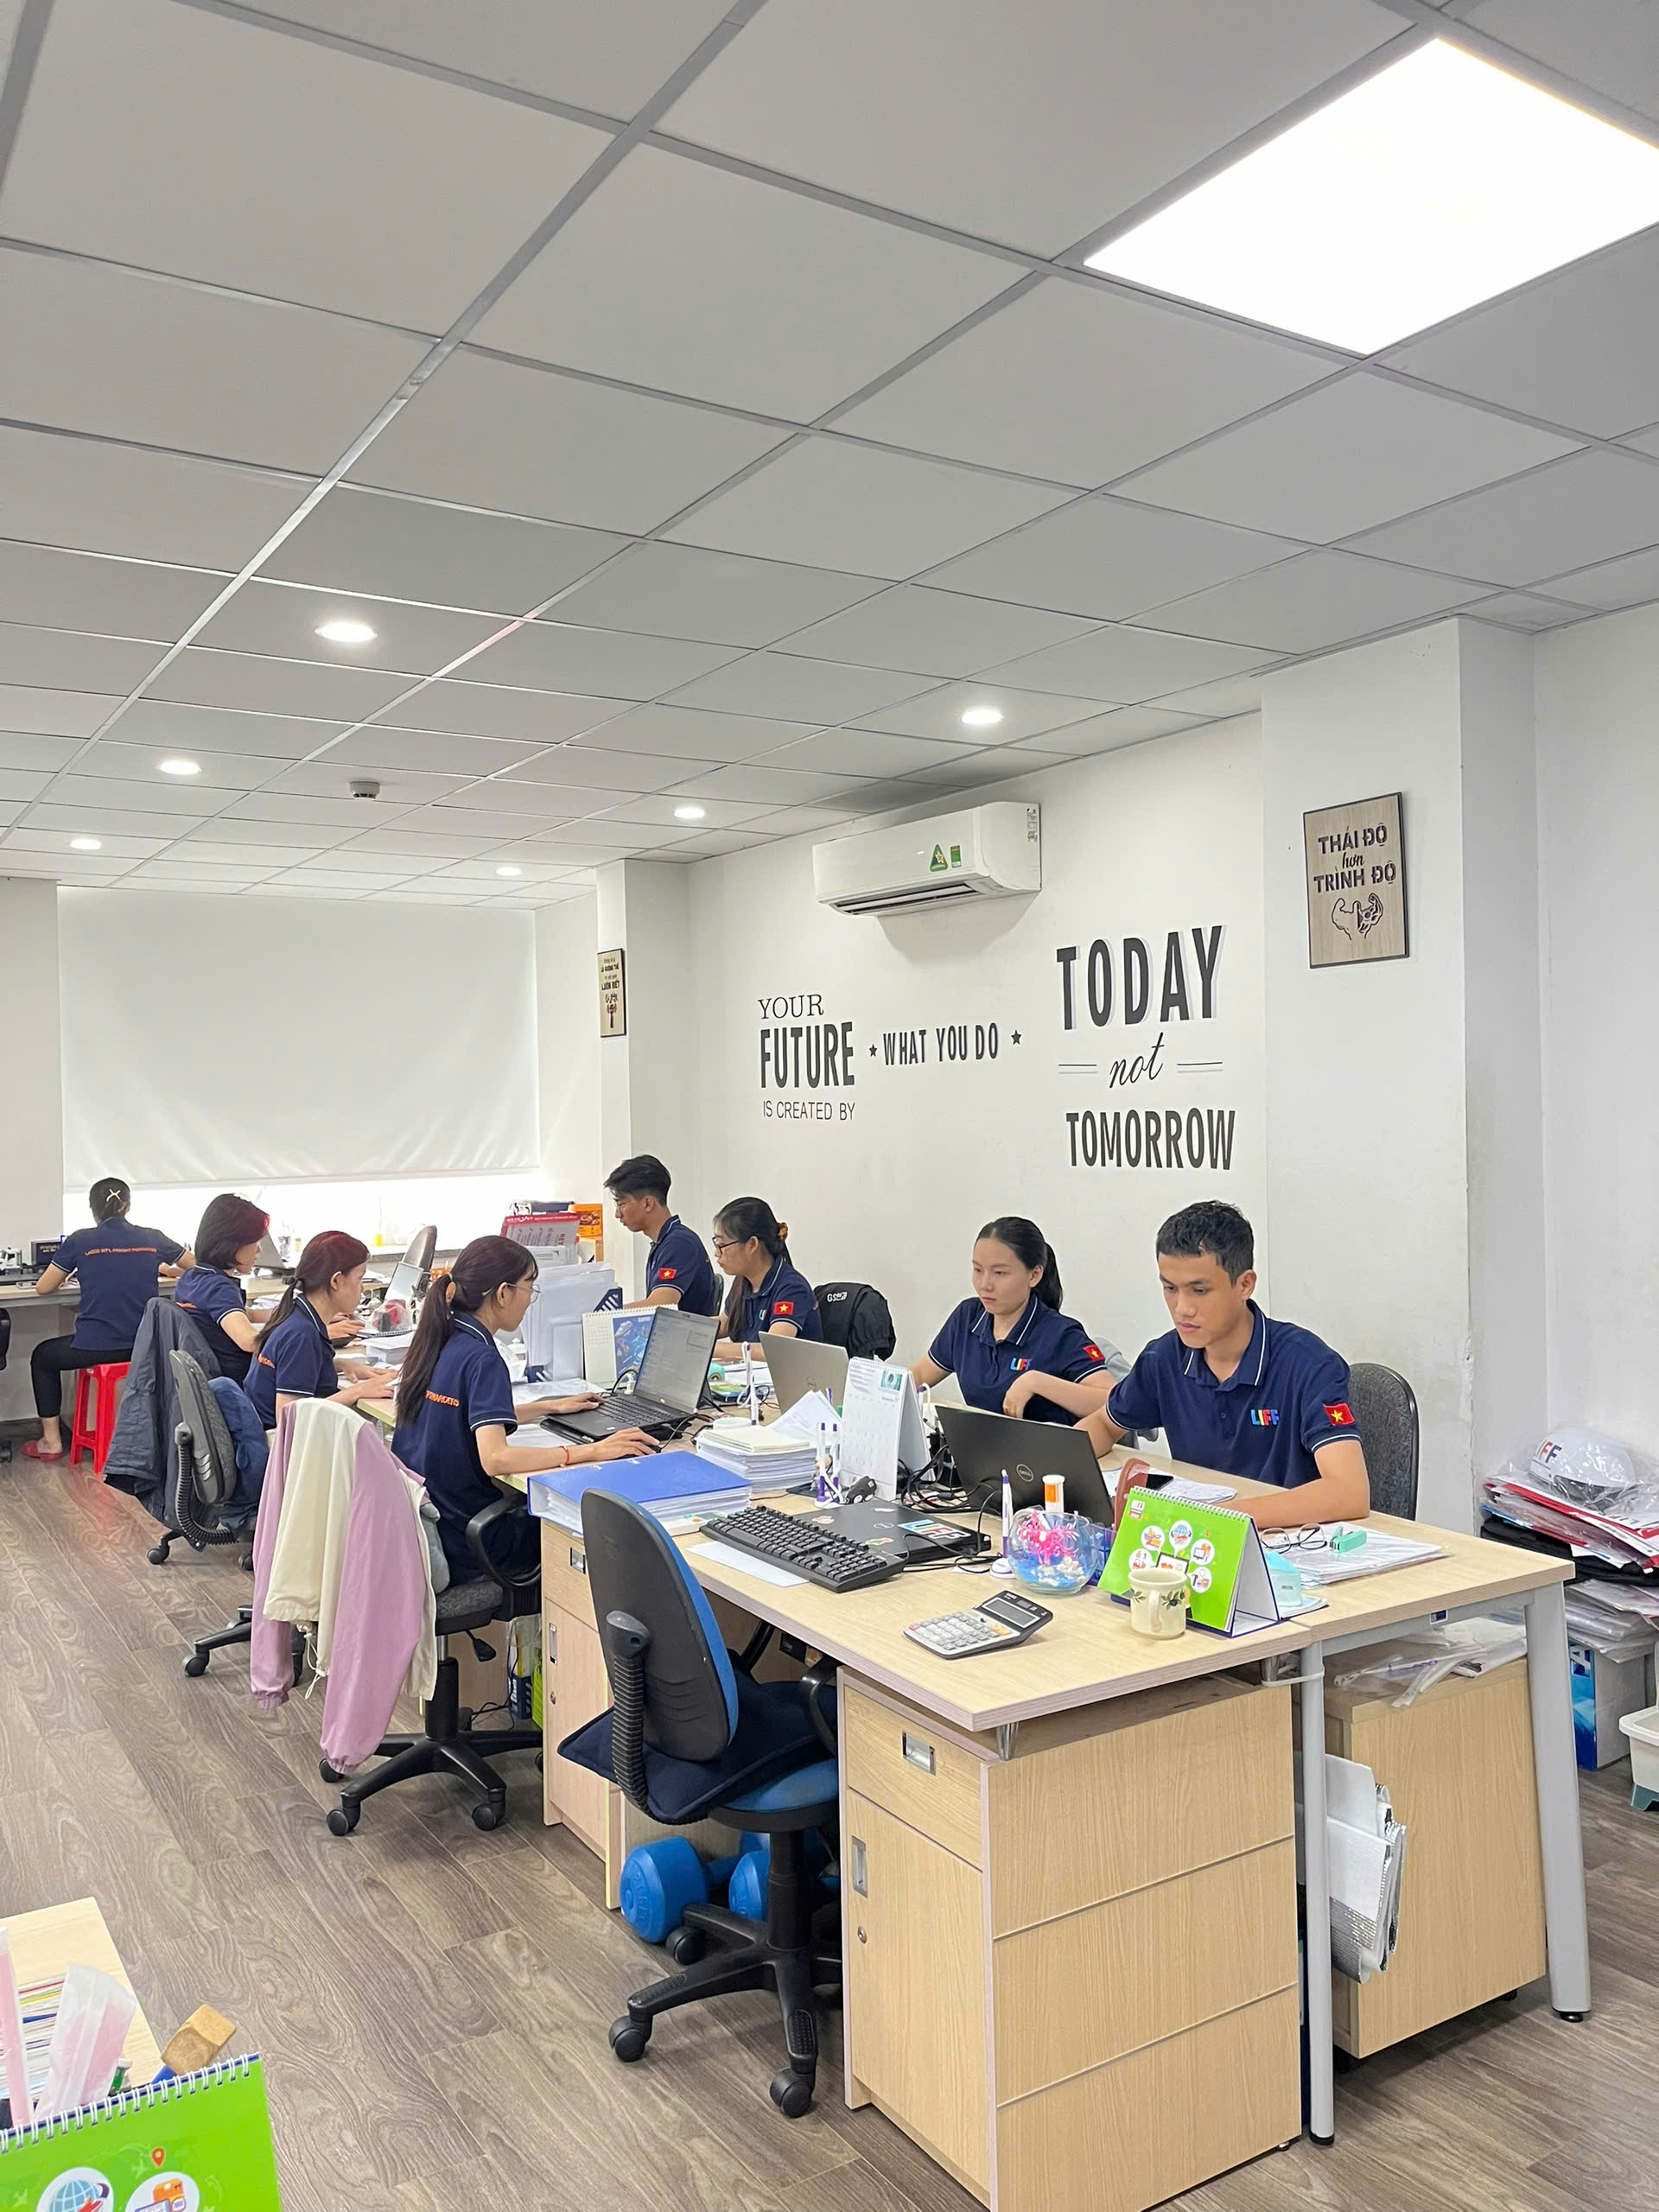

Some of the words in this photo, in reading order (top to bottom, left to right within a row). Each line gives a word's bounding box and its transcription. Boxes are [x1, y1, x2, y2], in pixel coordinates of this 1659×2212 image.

[1318, 825, 1358, 854] THÁI
[1363, 823, 1388, 847] ĐỘ
[1342, 851, 1365, 868] hơn
[1313, 867, 1365, 893] TRÌNH
[1371, 860, 1396, 885] ĐỘ
[1056, 925, 1224, 1030] TODAY
[757, 994, 824, 1020] YOUR
[760, 1021, 855, 1089] FUTURE
[882, 1029, 927, 1066] WHAT
[936, 1025, 968, 1062] YOU
[975, 1022, 999, 1060] DO
[1109, 1032, 1165, 1089] not
[763, 1100, 772, 1117] IS
[776, 1101, 833, 1121] CREATED
[839, 1103, 855, 1121] BY
[1065, 1107, 1236, 1171] TOMORROW
[1250, 1408, 1280, 1426] LIFF
